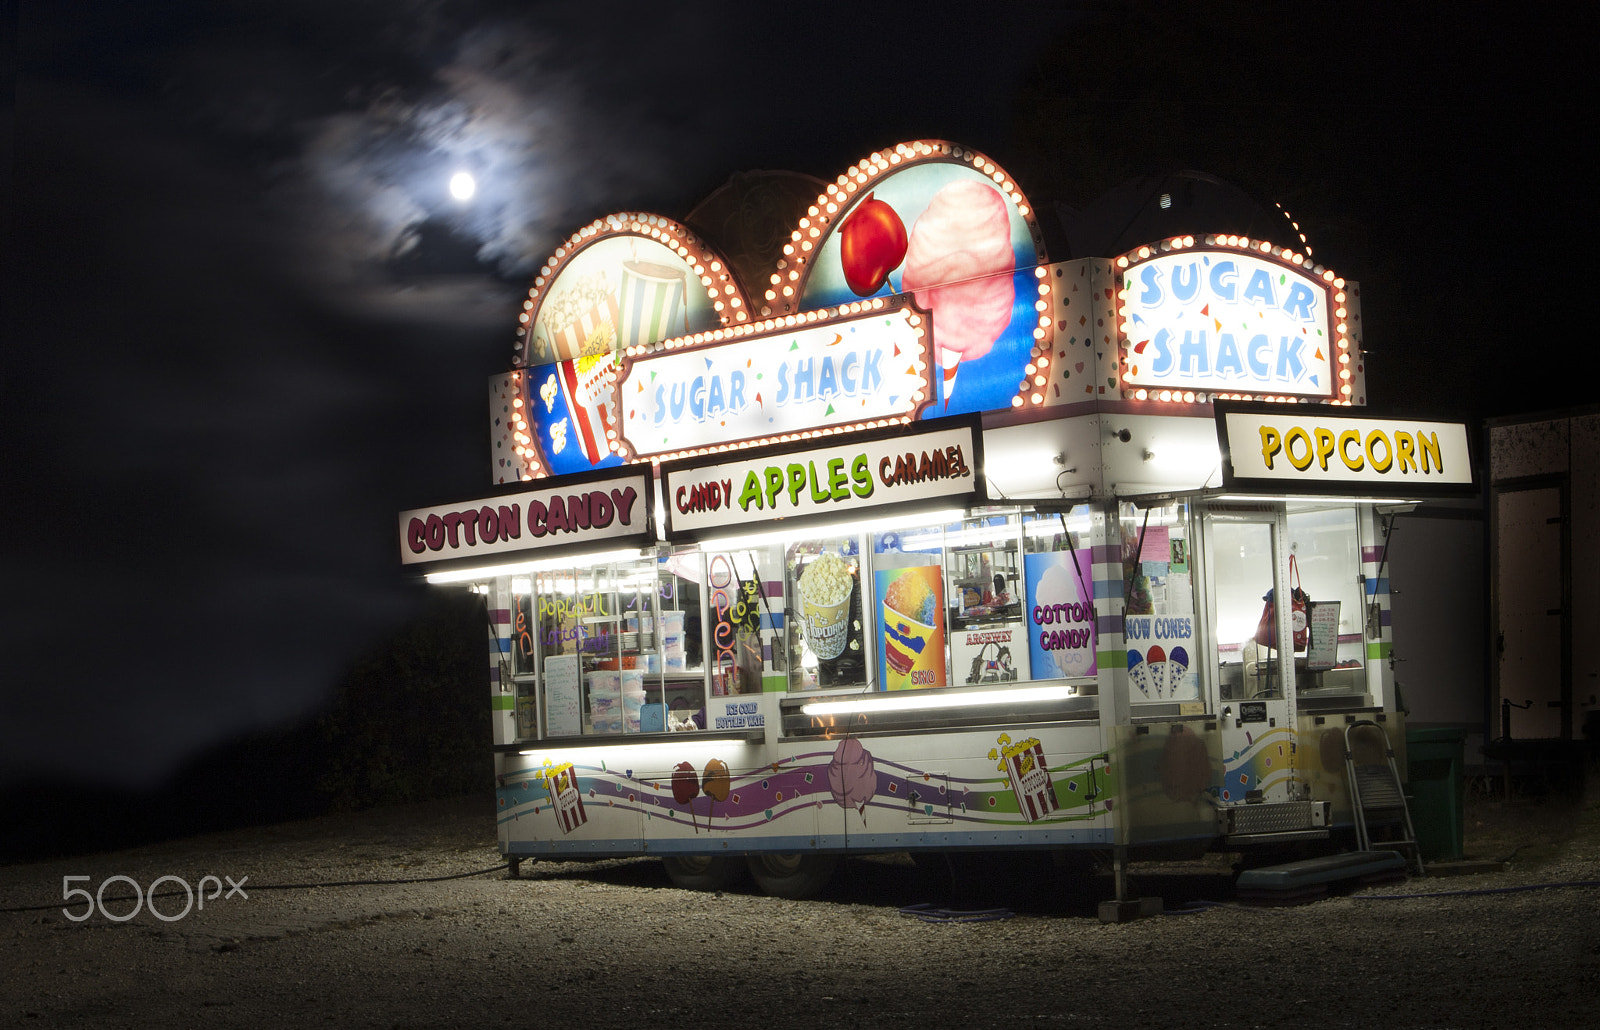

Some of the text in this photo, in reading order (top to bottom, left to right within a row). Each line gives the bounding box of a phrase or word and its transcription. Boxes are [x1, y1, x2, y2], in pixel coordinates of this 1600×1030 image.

[1140, 259, 1318, 323] SUGAR
[1152, 327, 1308, 383] SHACK
[653, 370, 749, 428] SUGAR
[776, 348, 885, 407] SHACK
[1259, 425, 1444, 474] POPCORN
[675, 444, 971, 514] CANDY APPLES CARAMEL
[407, 486, 638, 554] COTTON CANDY
[1033, 602, 1094, 625] COTTON
[808, 613, 846, 641] POPCORN
[966, 630, 1012, 645] ARCHWAY
[1040, 628, 1090, 651] CANDY
[1126, 617, 1192, 640] NOW CONES
[911, 669, 936, 685] SNO
[725, 702, 758, 716] ICE COLD
[746, 714, 765, 727] WATE
